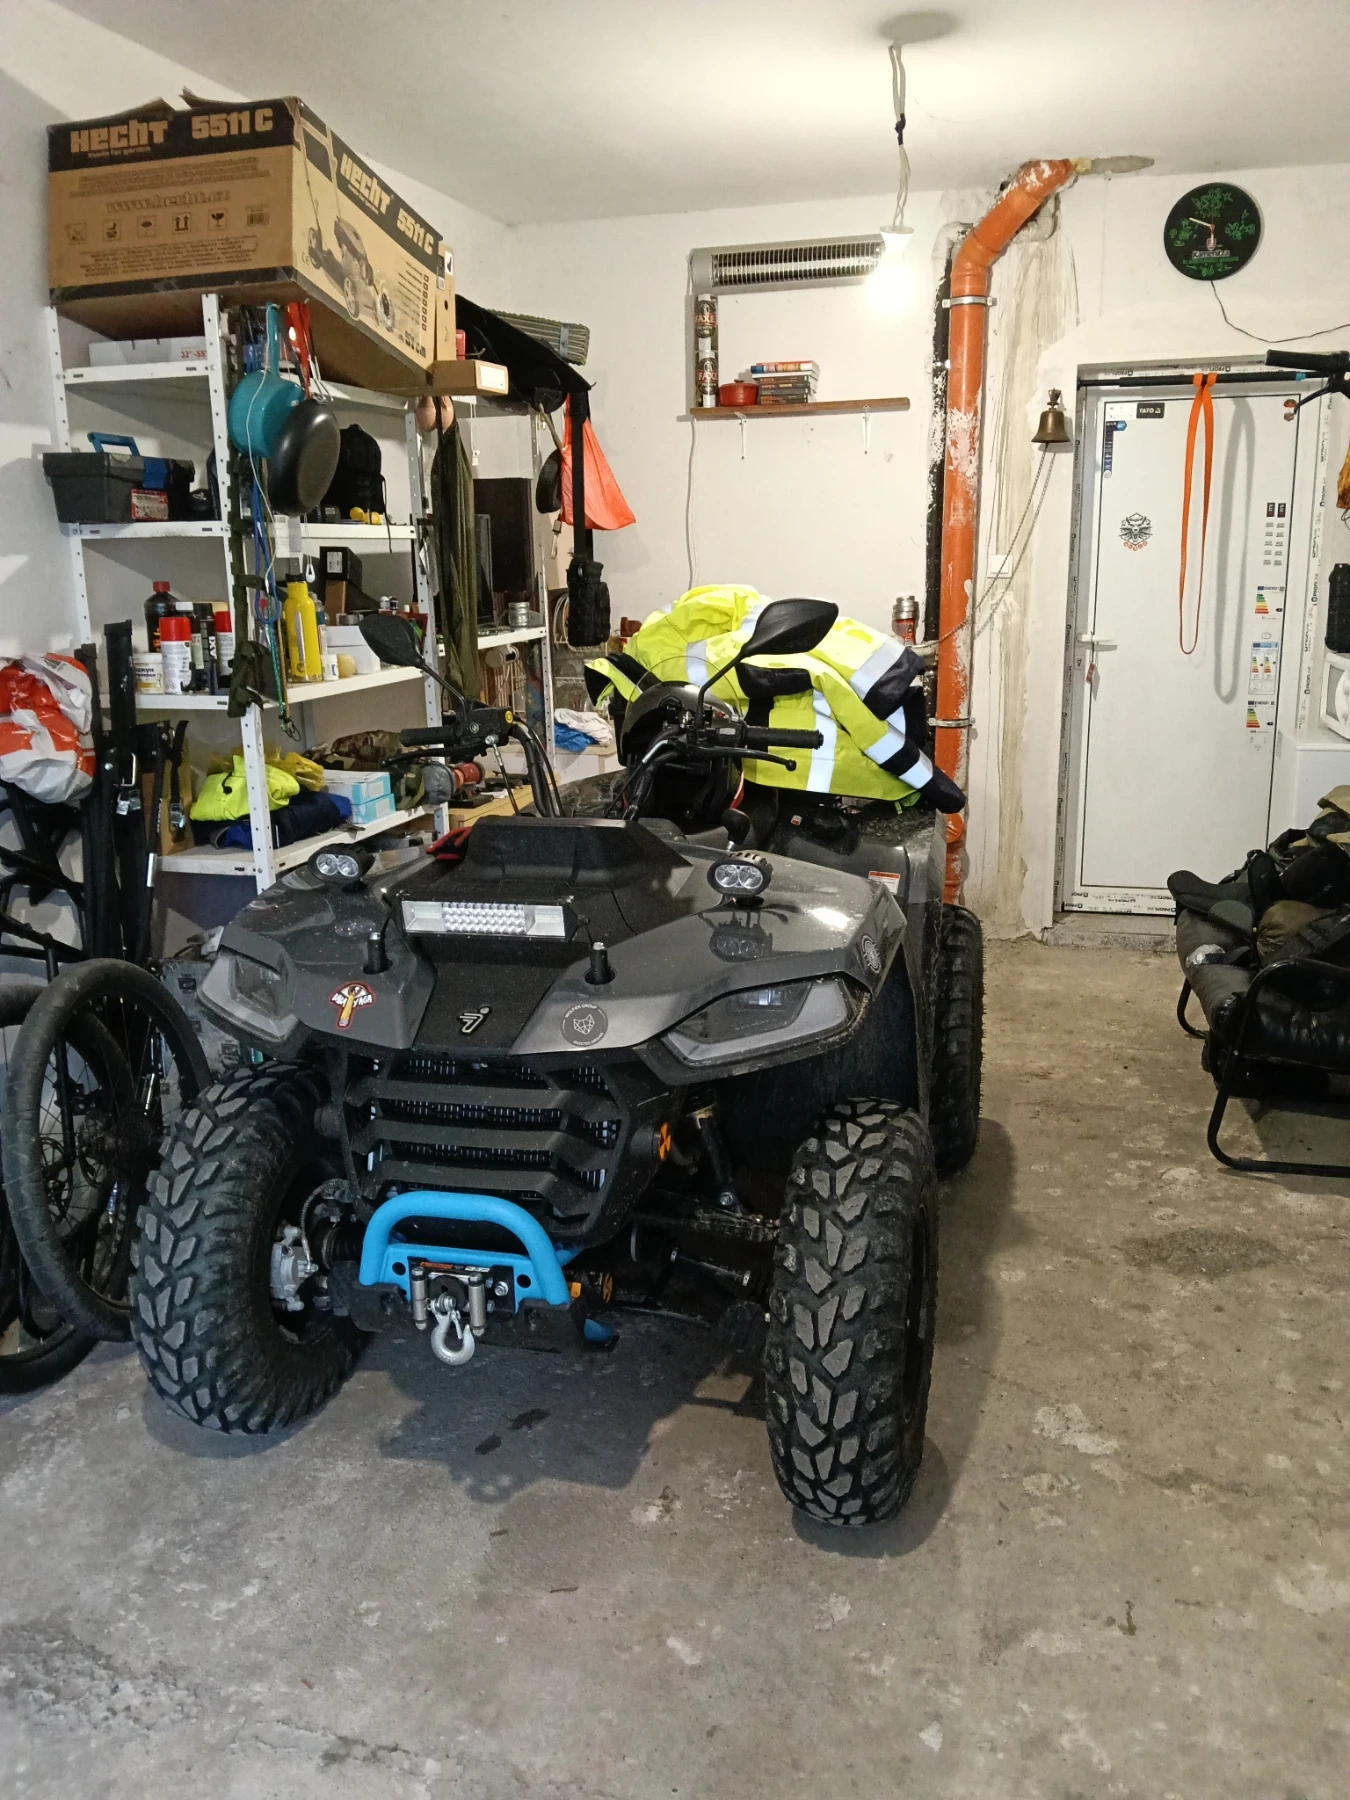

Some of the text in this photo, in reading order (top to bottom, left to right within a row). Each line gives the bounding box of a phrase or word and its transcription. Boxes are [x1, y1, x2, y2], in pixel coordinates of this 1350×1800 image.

[191, 110, 250, 140] 5511
[254, 107, 274, 132] C
[396, 207, 427, 248] 5511
[426, 234, 435, 255] C
